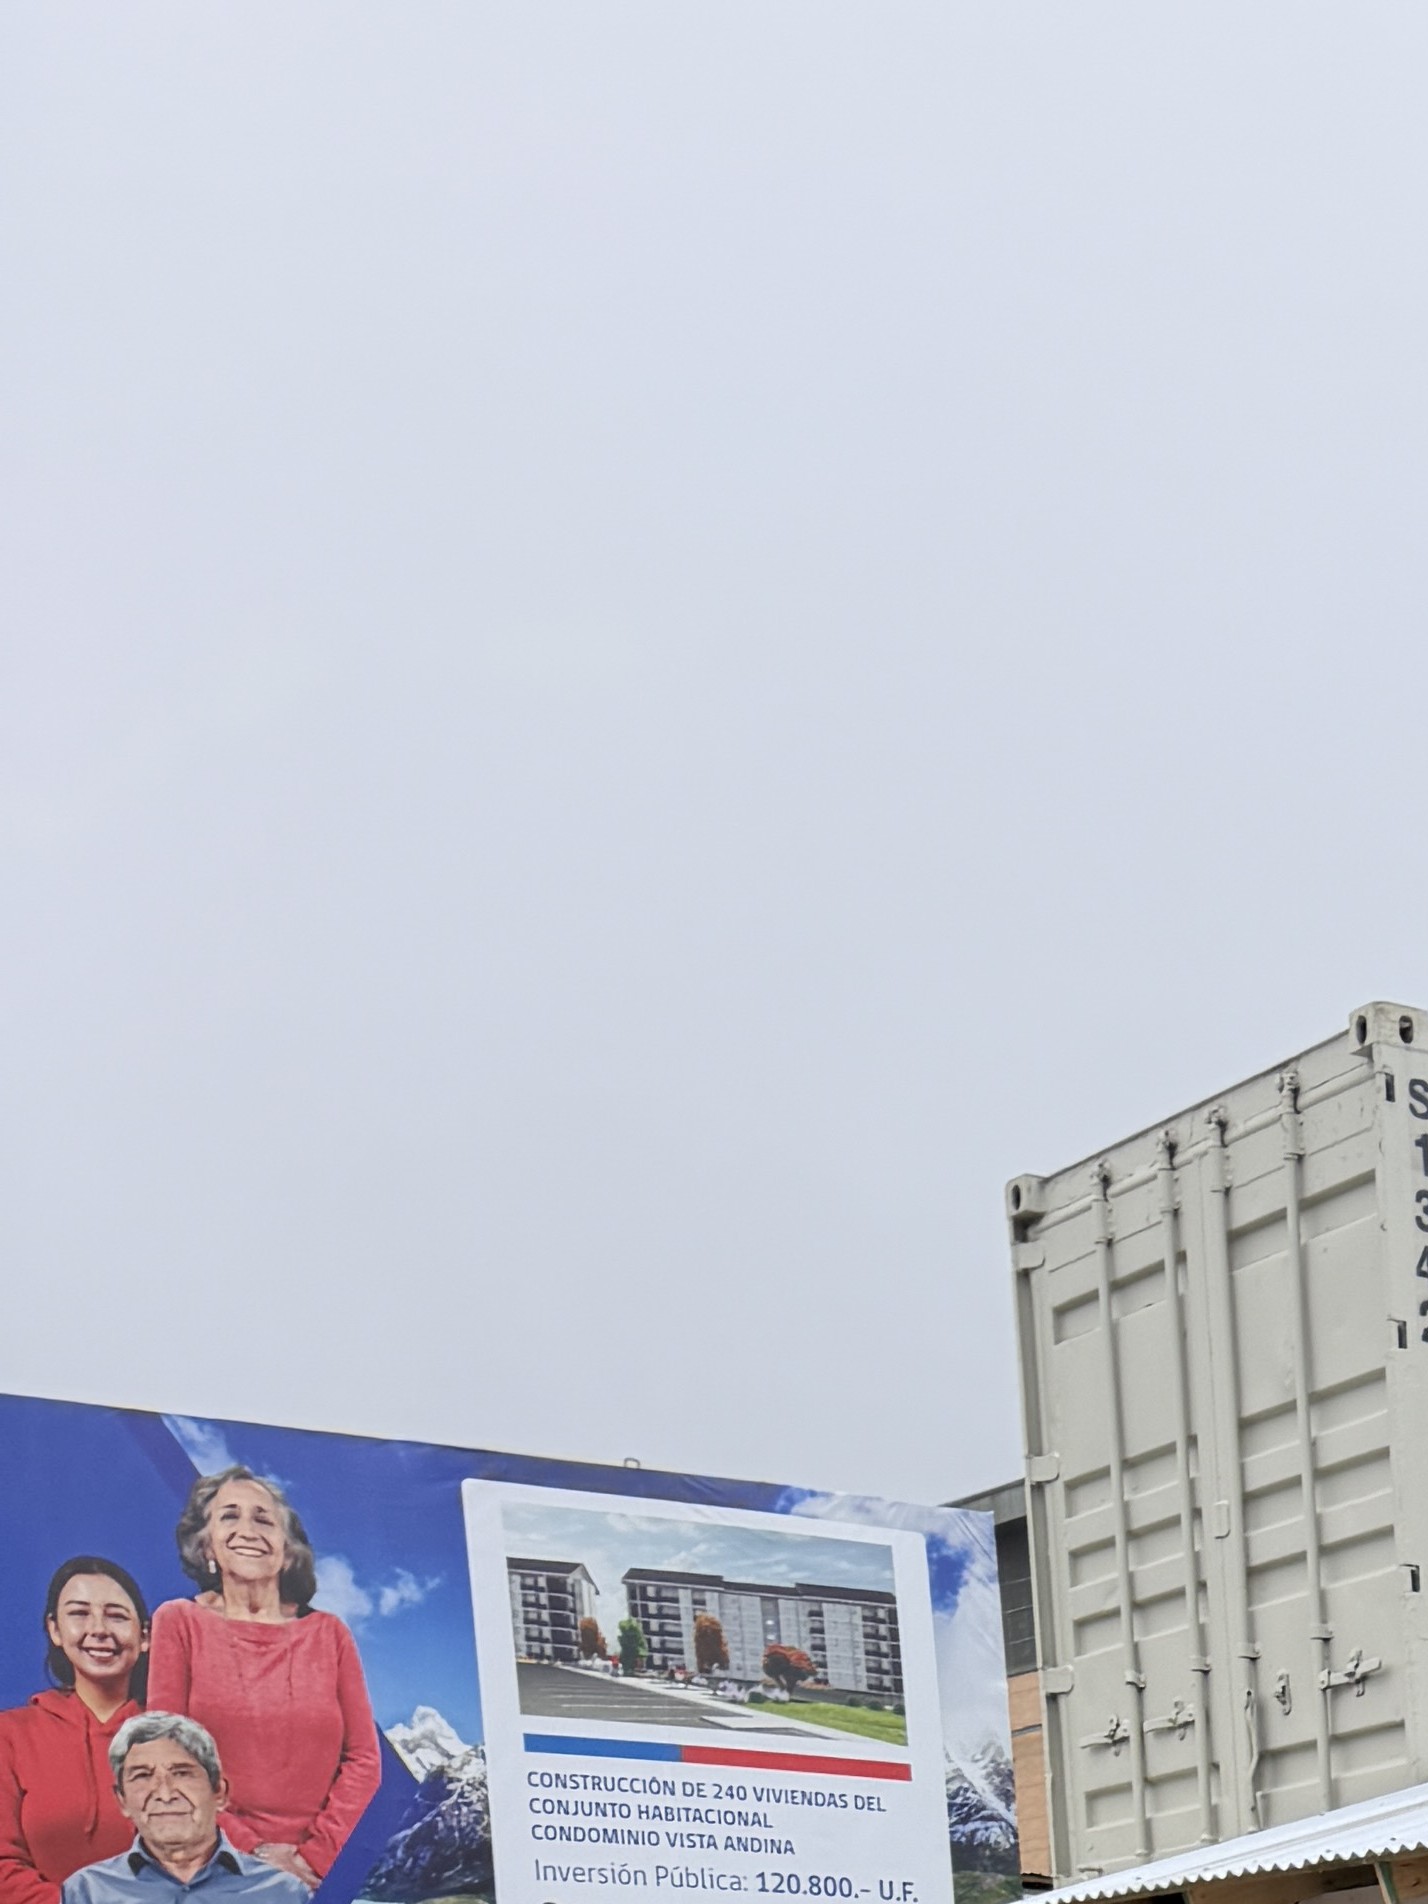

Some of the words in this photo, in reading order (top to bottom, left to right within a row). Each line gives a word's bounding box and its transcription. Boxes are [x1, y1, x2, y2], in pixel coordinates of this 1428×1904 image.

[527, 1771, 676, 1797] CONSTRUCCIÓN
[682, 1781, 707, 1798] DE
[713, 1784, 748, 1801] 240
[752, 1786, 848, 1809] VIVIENDAS
[854, 1795, 887, 1813] DEL
[529, 1797, 632, 1820] CONJUNTO
[637, 1804, 774, 1829] HABITACIONAL
[531, 1824, 660, 1847] CONDOMINIO
[665, 1832, 718, 1851] VISTA
[723, 1836, 796, 1856] ANDINA
[535, 1860, 648, 1887] Inversión
[655, 1866, 749, 1892] Pública:
[756, 1871, 871, 1899] 120.800.-
[878, 1879, 919, 1903] U.F.
